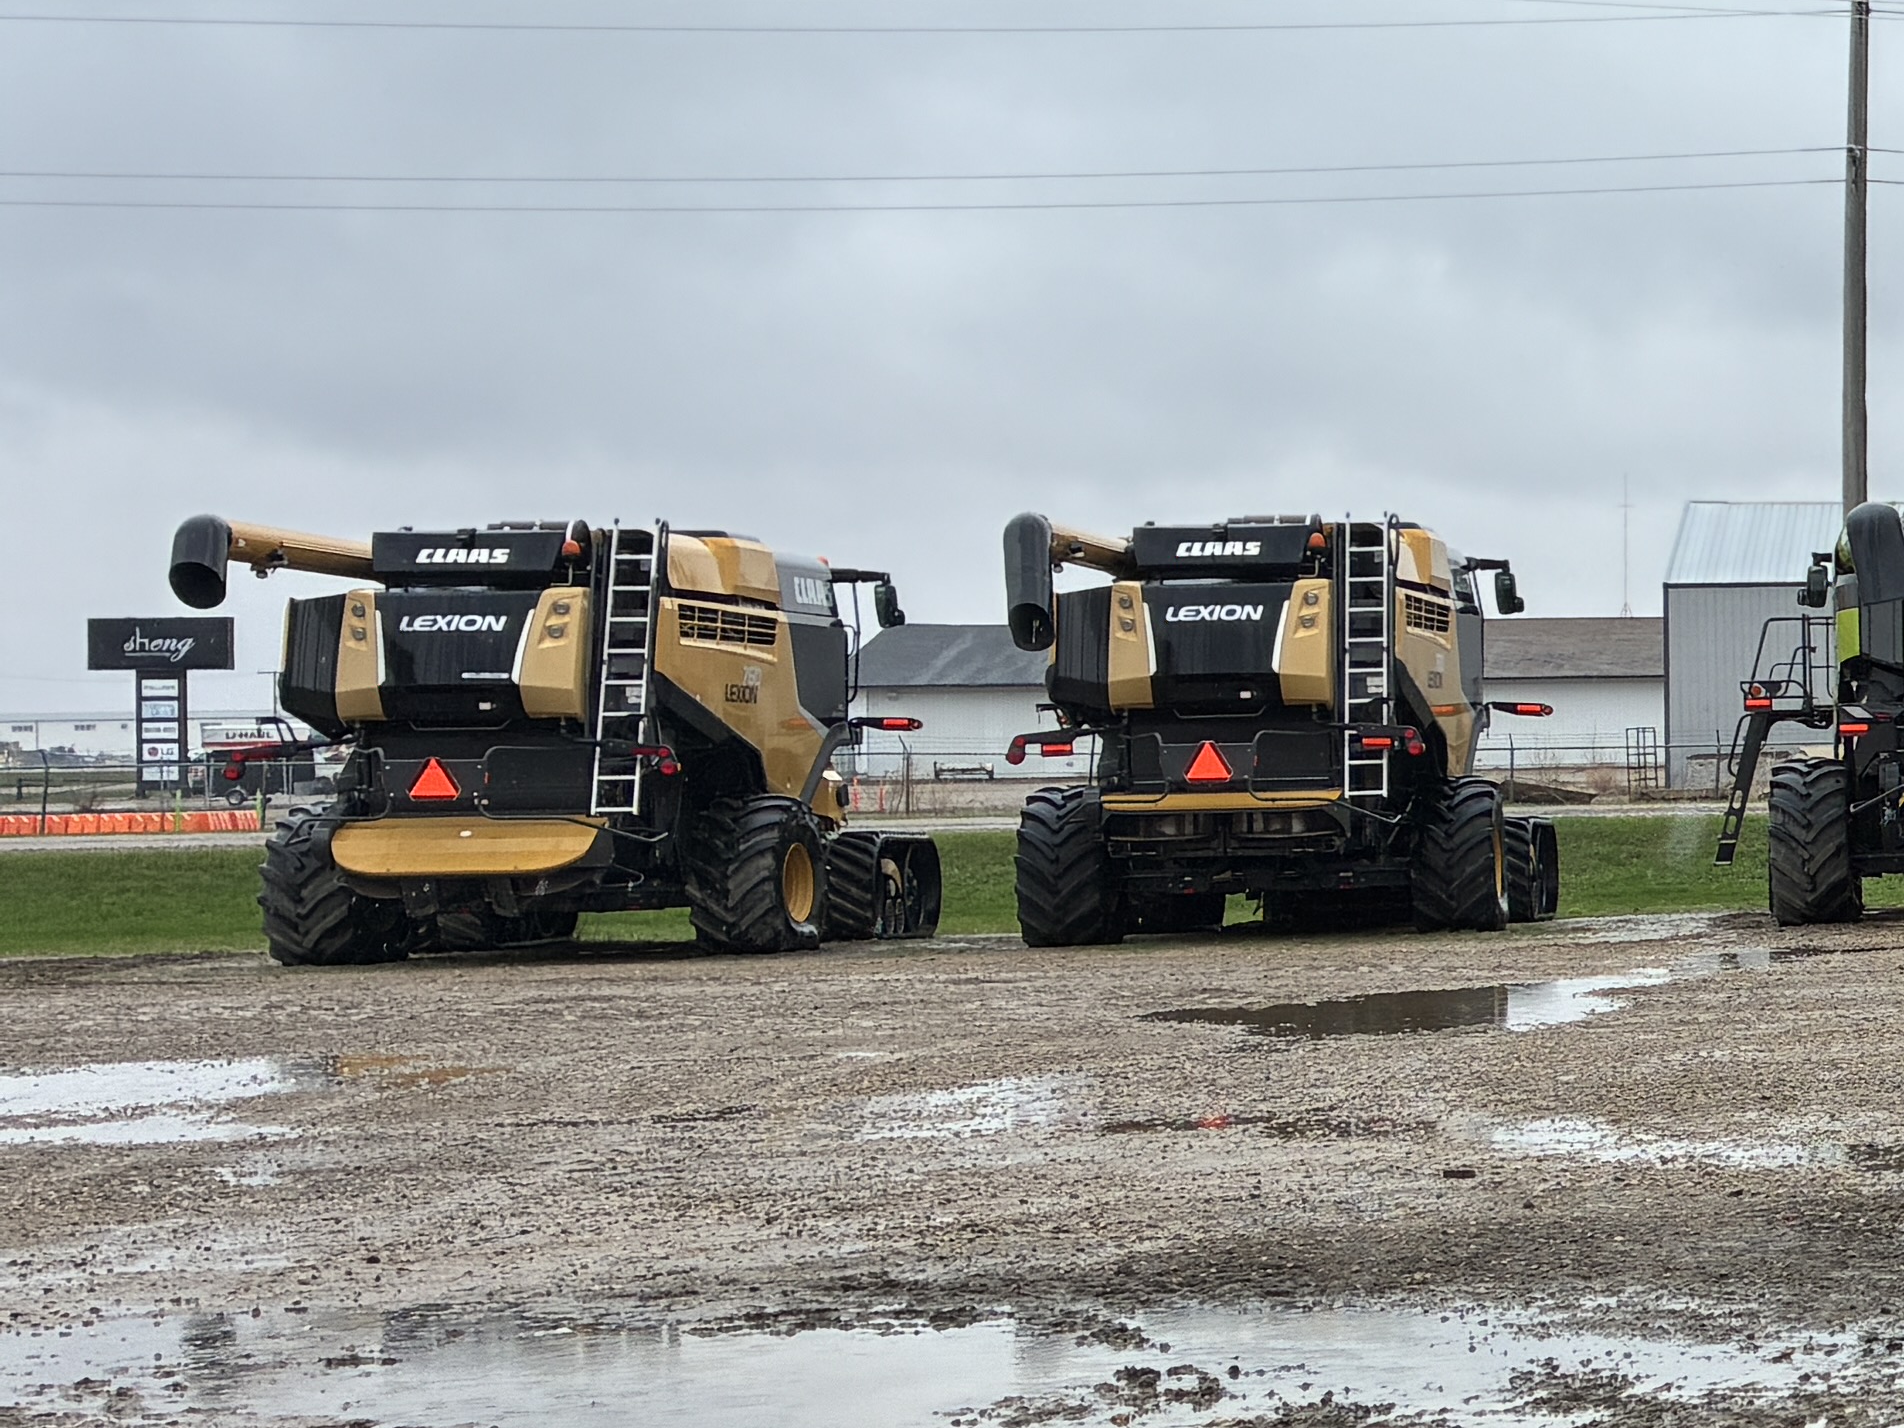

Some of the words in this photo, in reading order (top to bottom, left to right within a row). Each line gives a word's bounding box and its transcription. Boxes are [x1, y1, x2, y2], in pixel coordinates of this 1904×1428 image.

[415, 548, 511, 564] CLAAS
[1175, 541, 1262, 557] CLAAS
[1165, 604, 1264, 622] LEXION
[399, 614, 507, 632] LEXION
